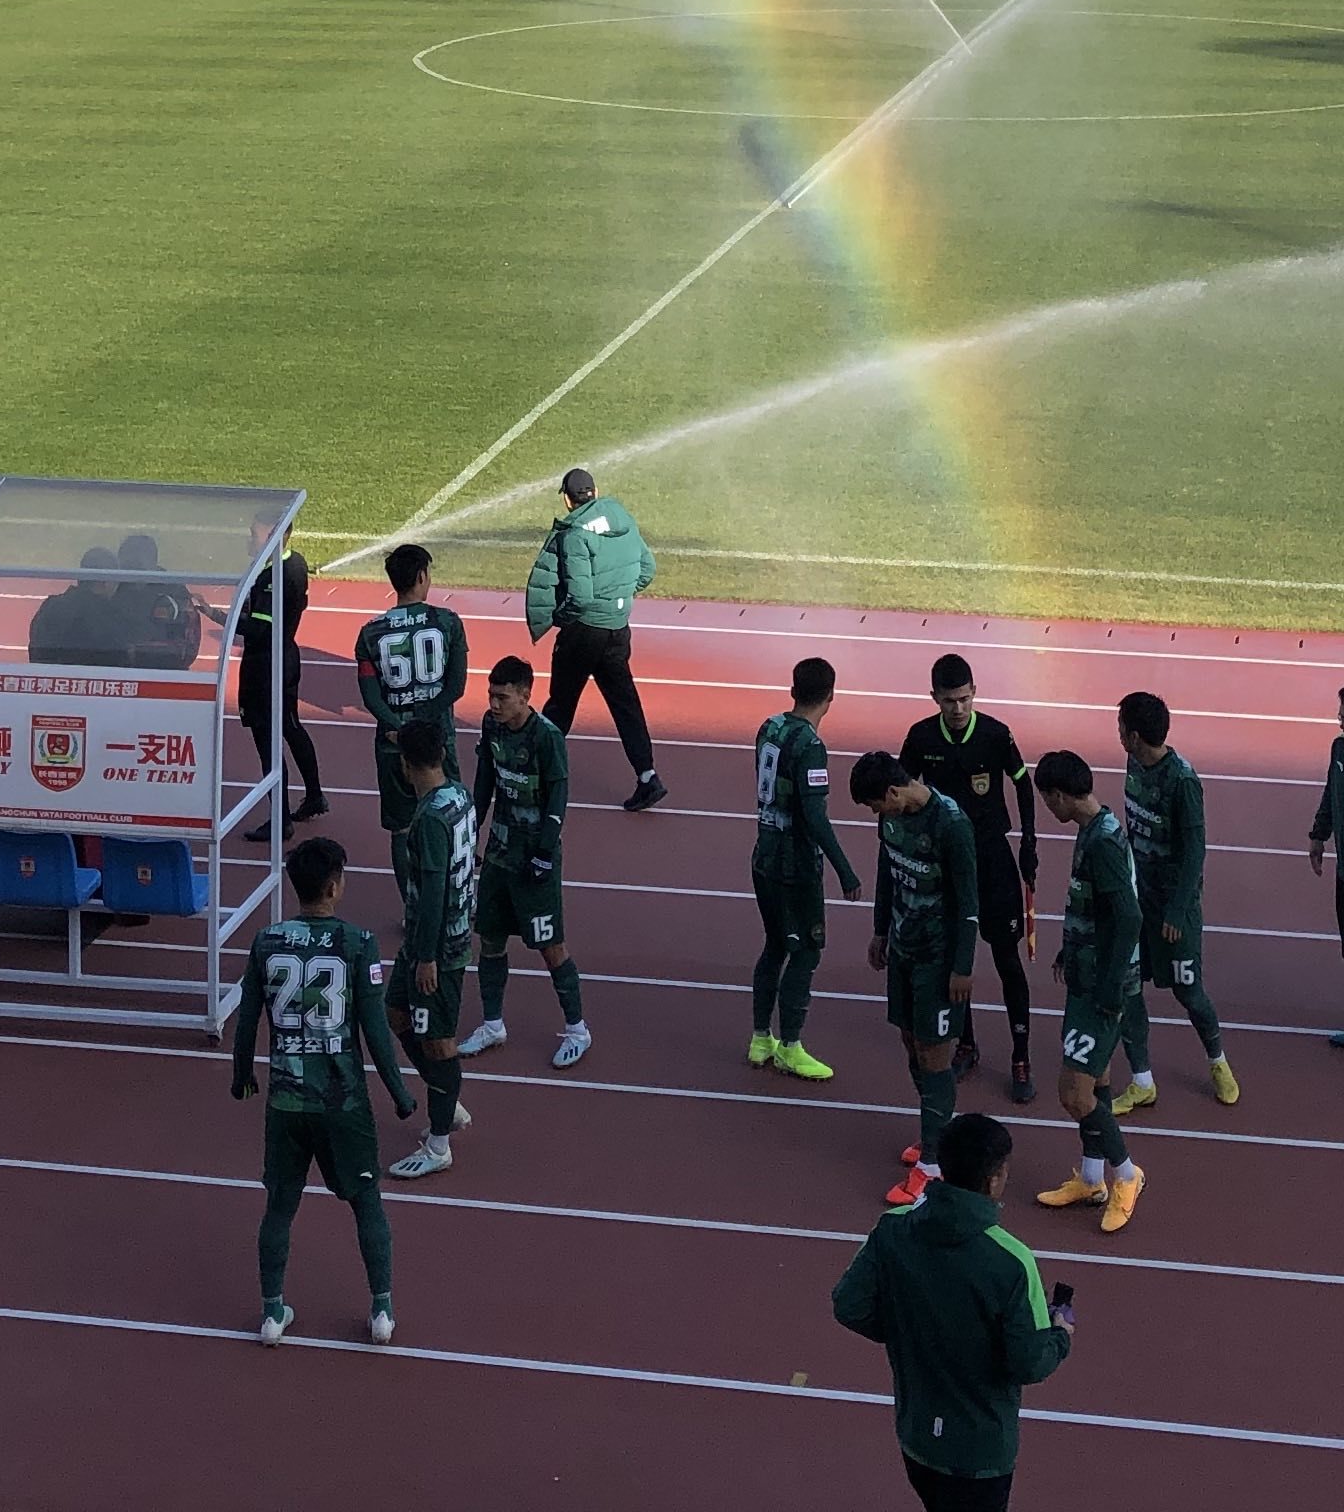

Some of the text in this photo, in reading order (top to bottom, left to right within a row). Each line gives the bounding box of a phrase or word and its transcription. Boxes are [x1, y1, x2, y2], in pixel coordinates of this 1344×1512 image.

[377, 627, 445, 689] 60
[105, 734, 197, 767] 一支队
[102, 766, 197, 785] ONE TEAM
[38, 810, 64, 820] YATAI
[64, 811, 109, 823] FOOTBALL
[109, 813, 133, 824] CLUB
[284, 930, 334, 948] 许小龙
[530, 914, 554, 944] 15
[1171, 959, 1195, 986] 16
[265, 953, 347, 1031] 23
[937, 1008, 951, 1037] 6
[1063, 1028, 1096, 1066] 42
